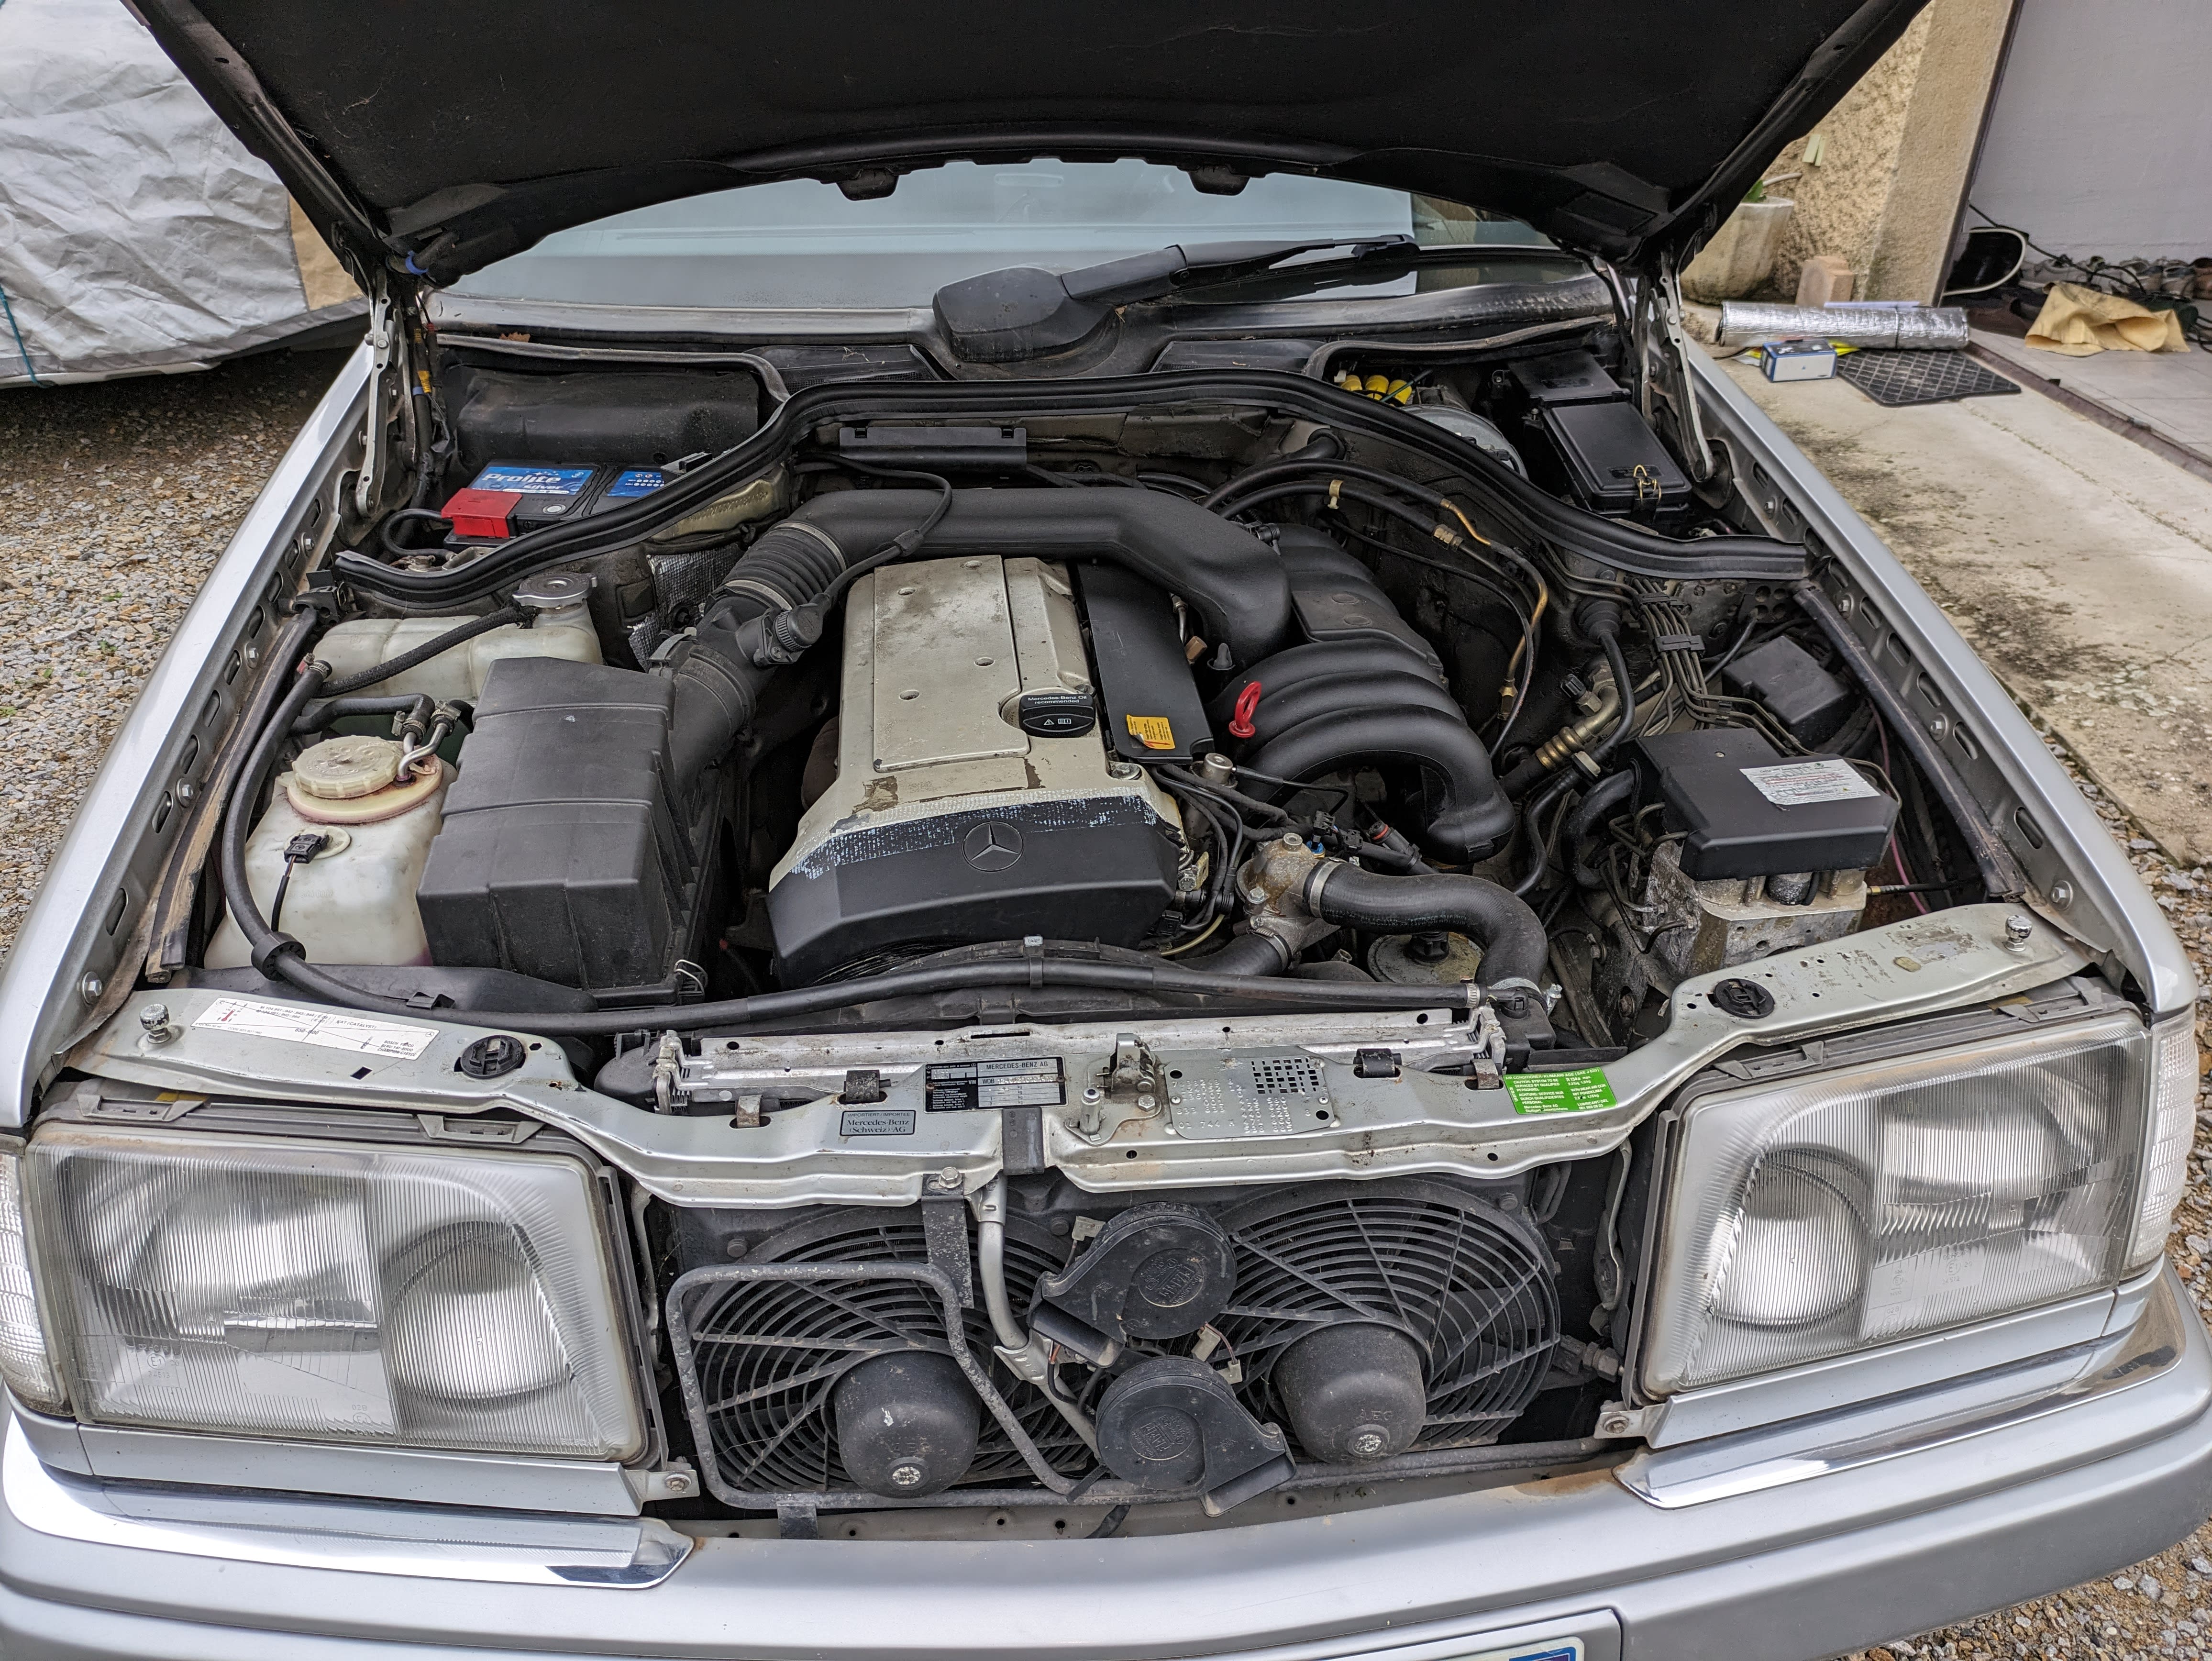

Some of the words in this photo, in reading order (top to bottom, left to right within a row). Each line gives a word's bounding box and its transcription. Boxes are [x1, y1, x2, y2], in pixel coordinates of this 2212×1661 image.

[482, 473, 562, 484] Prolite
[1200, 1120, 1221, 1128] 744
[1356, 1409, 1393, 1421] AEG
